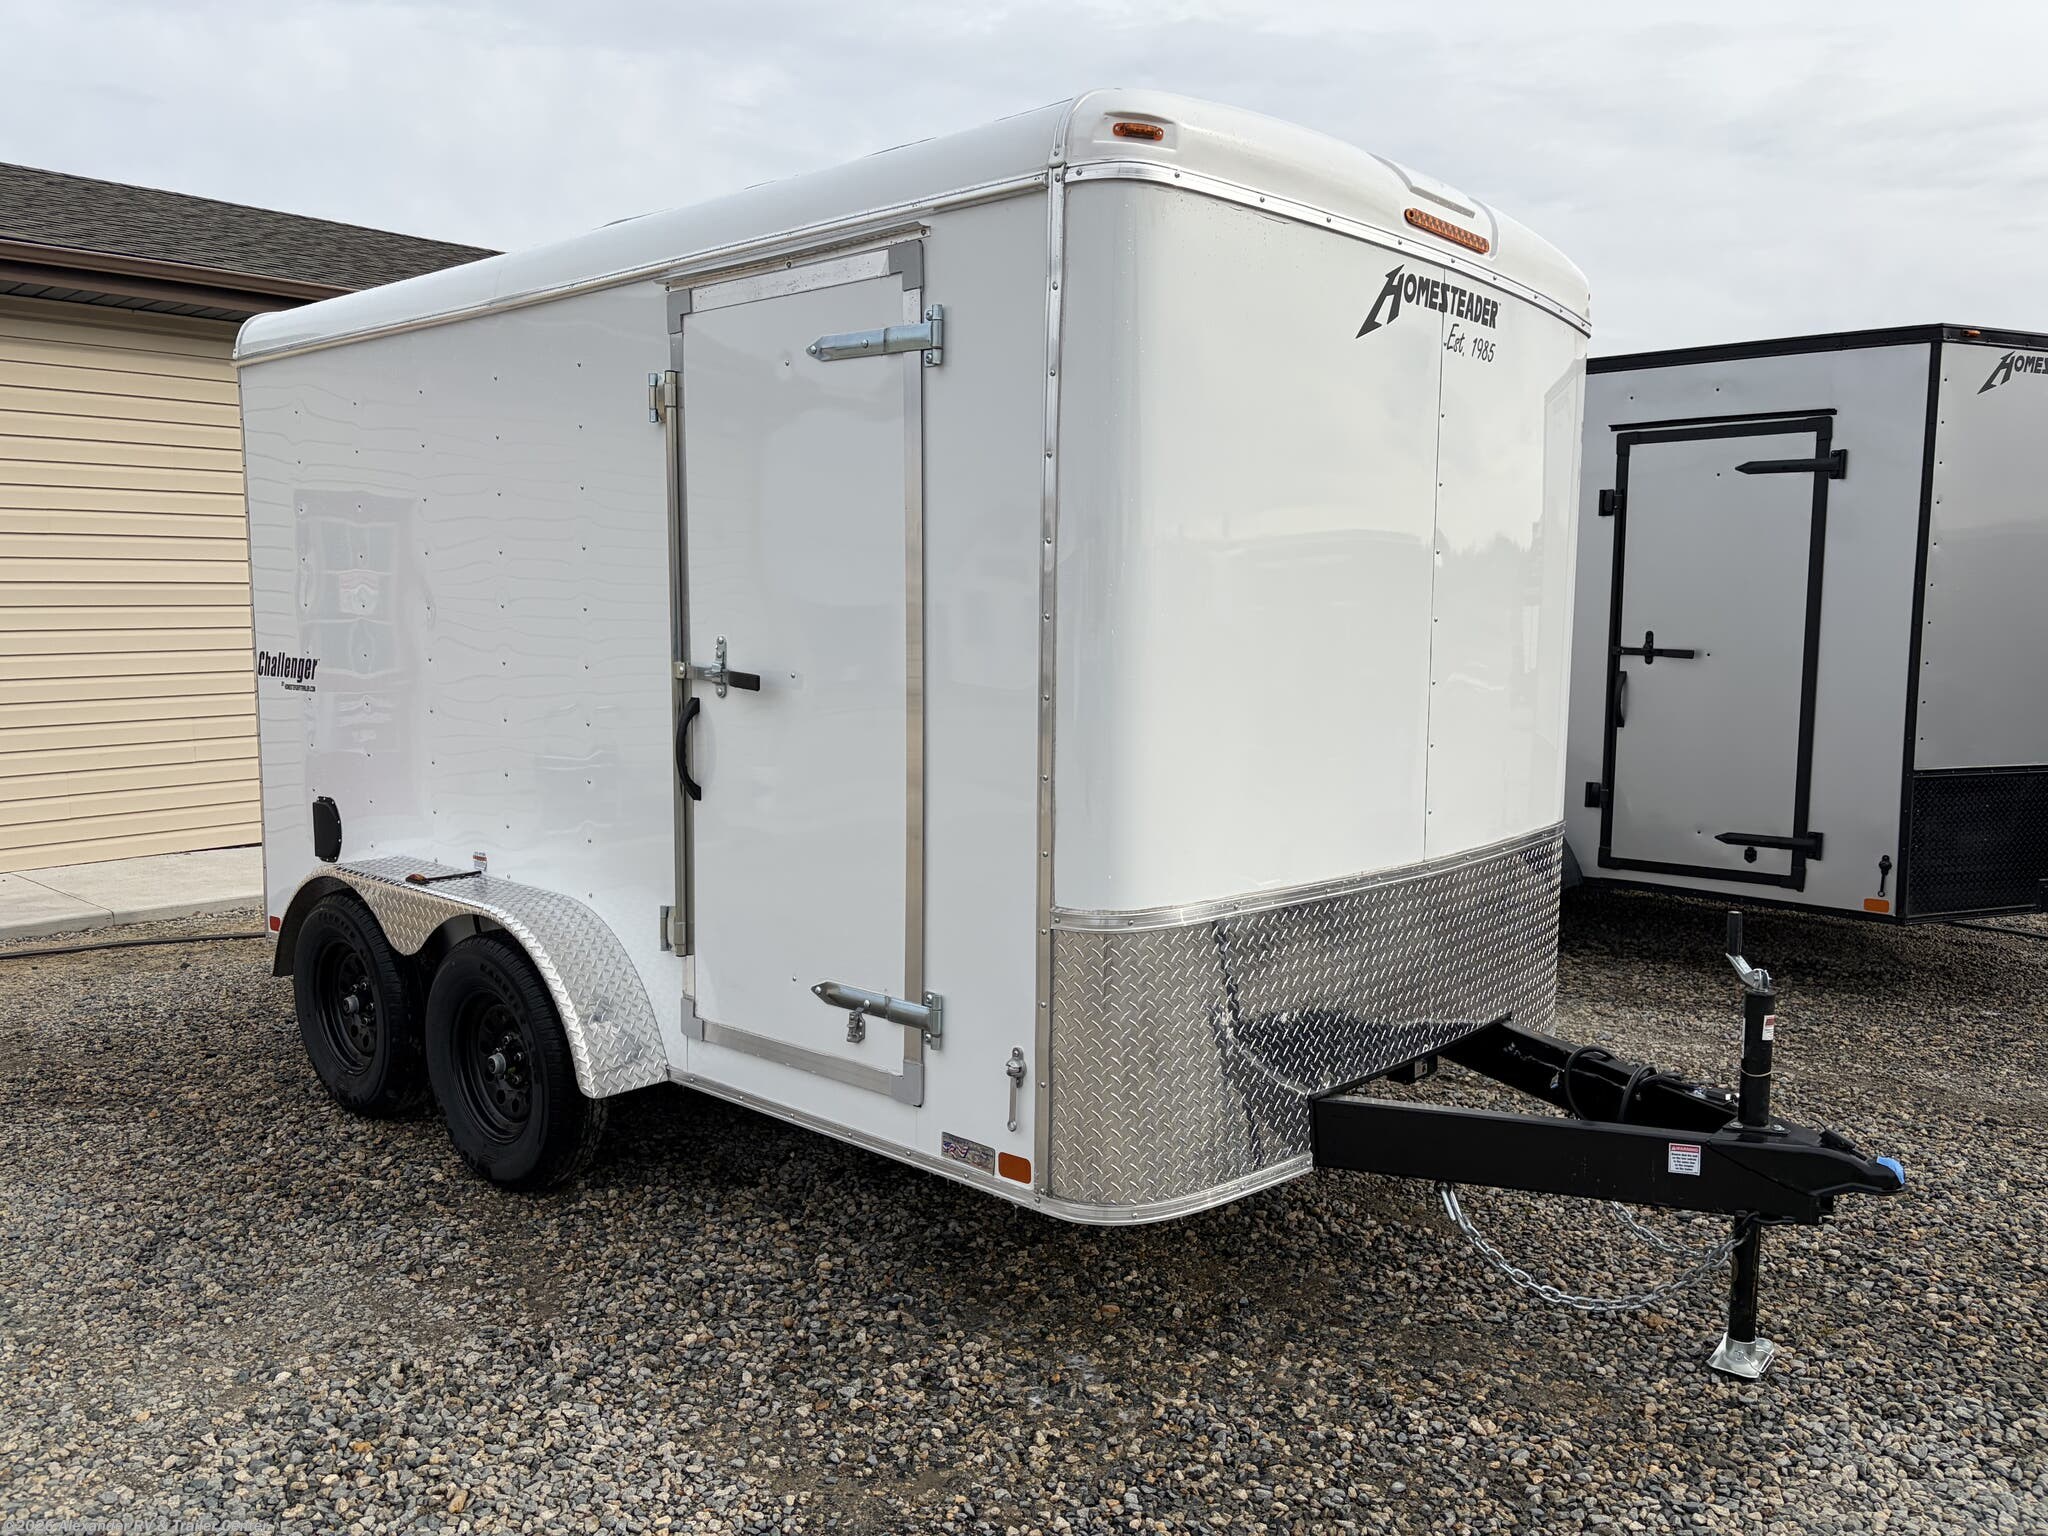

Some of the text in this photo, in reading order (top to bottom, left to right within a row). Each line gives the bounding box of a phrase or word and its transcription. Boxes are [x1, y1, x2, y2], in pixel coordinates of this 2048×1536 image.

[1355, 264, 1498, 339] HOMESTEADER
[1471, 337, 1497, 362] 1985
[258, 651, 318, 683] Challenger
